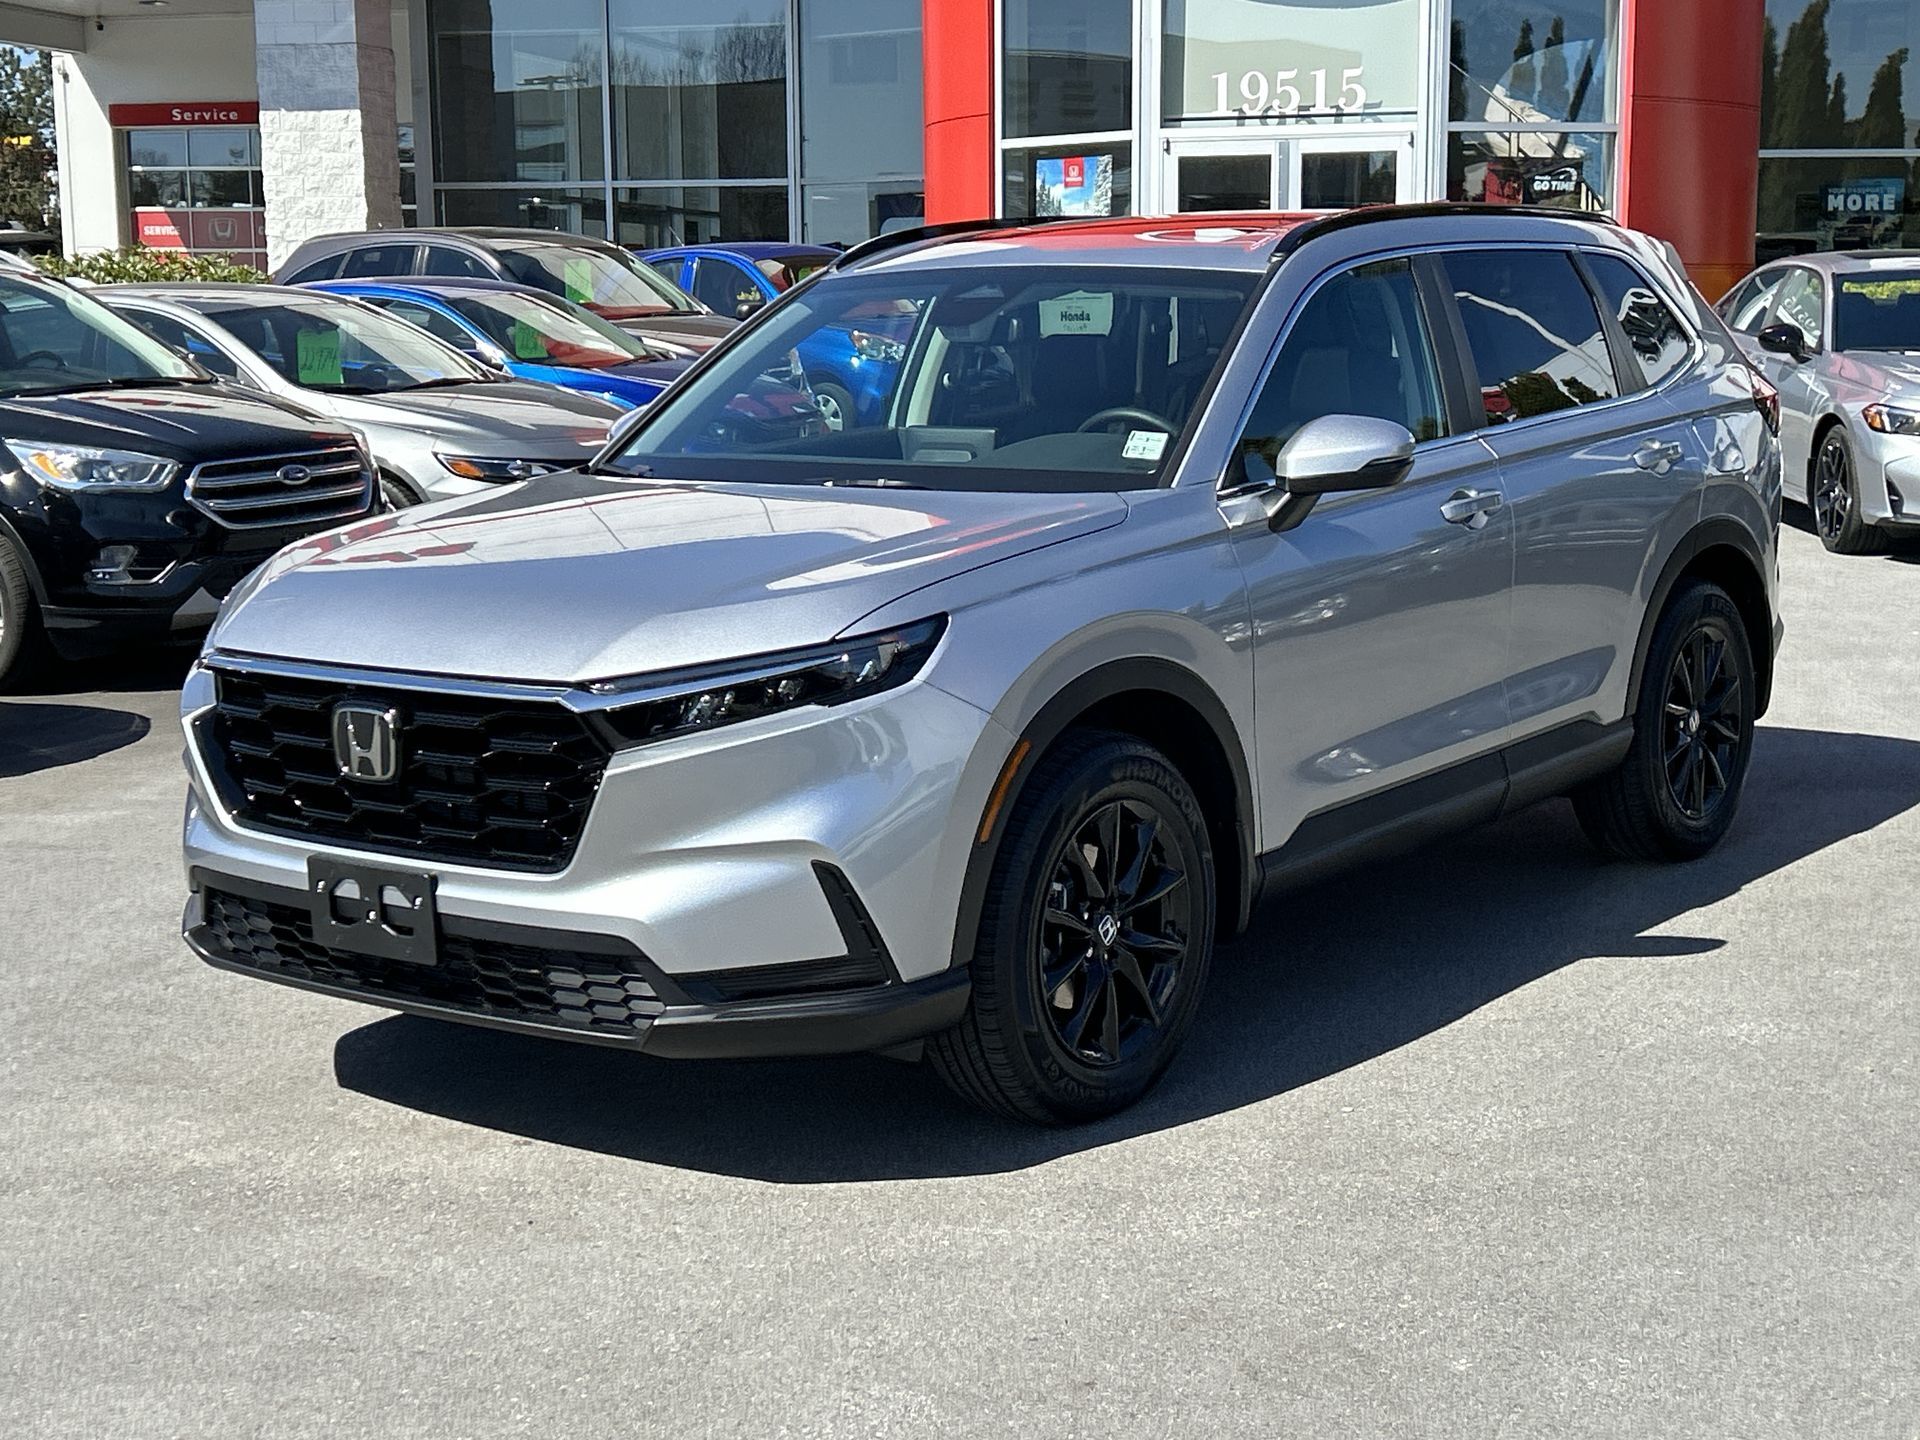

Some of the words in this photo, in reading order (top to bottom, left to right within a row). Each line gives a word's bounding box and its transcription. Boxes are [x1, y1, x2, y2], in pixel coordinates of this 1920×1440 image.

[1211, 66, 1367, 115] 19515
[171, 108, 239, 121] Service
[1533, 181, 1550, 191] GO
[1551, 181, 1576, 191] TIME
[1827, 193, 1896, 212] MORE
[143, 225, 181, 236] SERVICE
[1060, 310, 1091, 322] Honda
